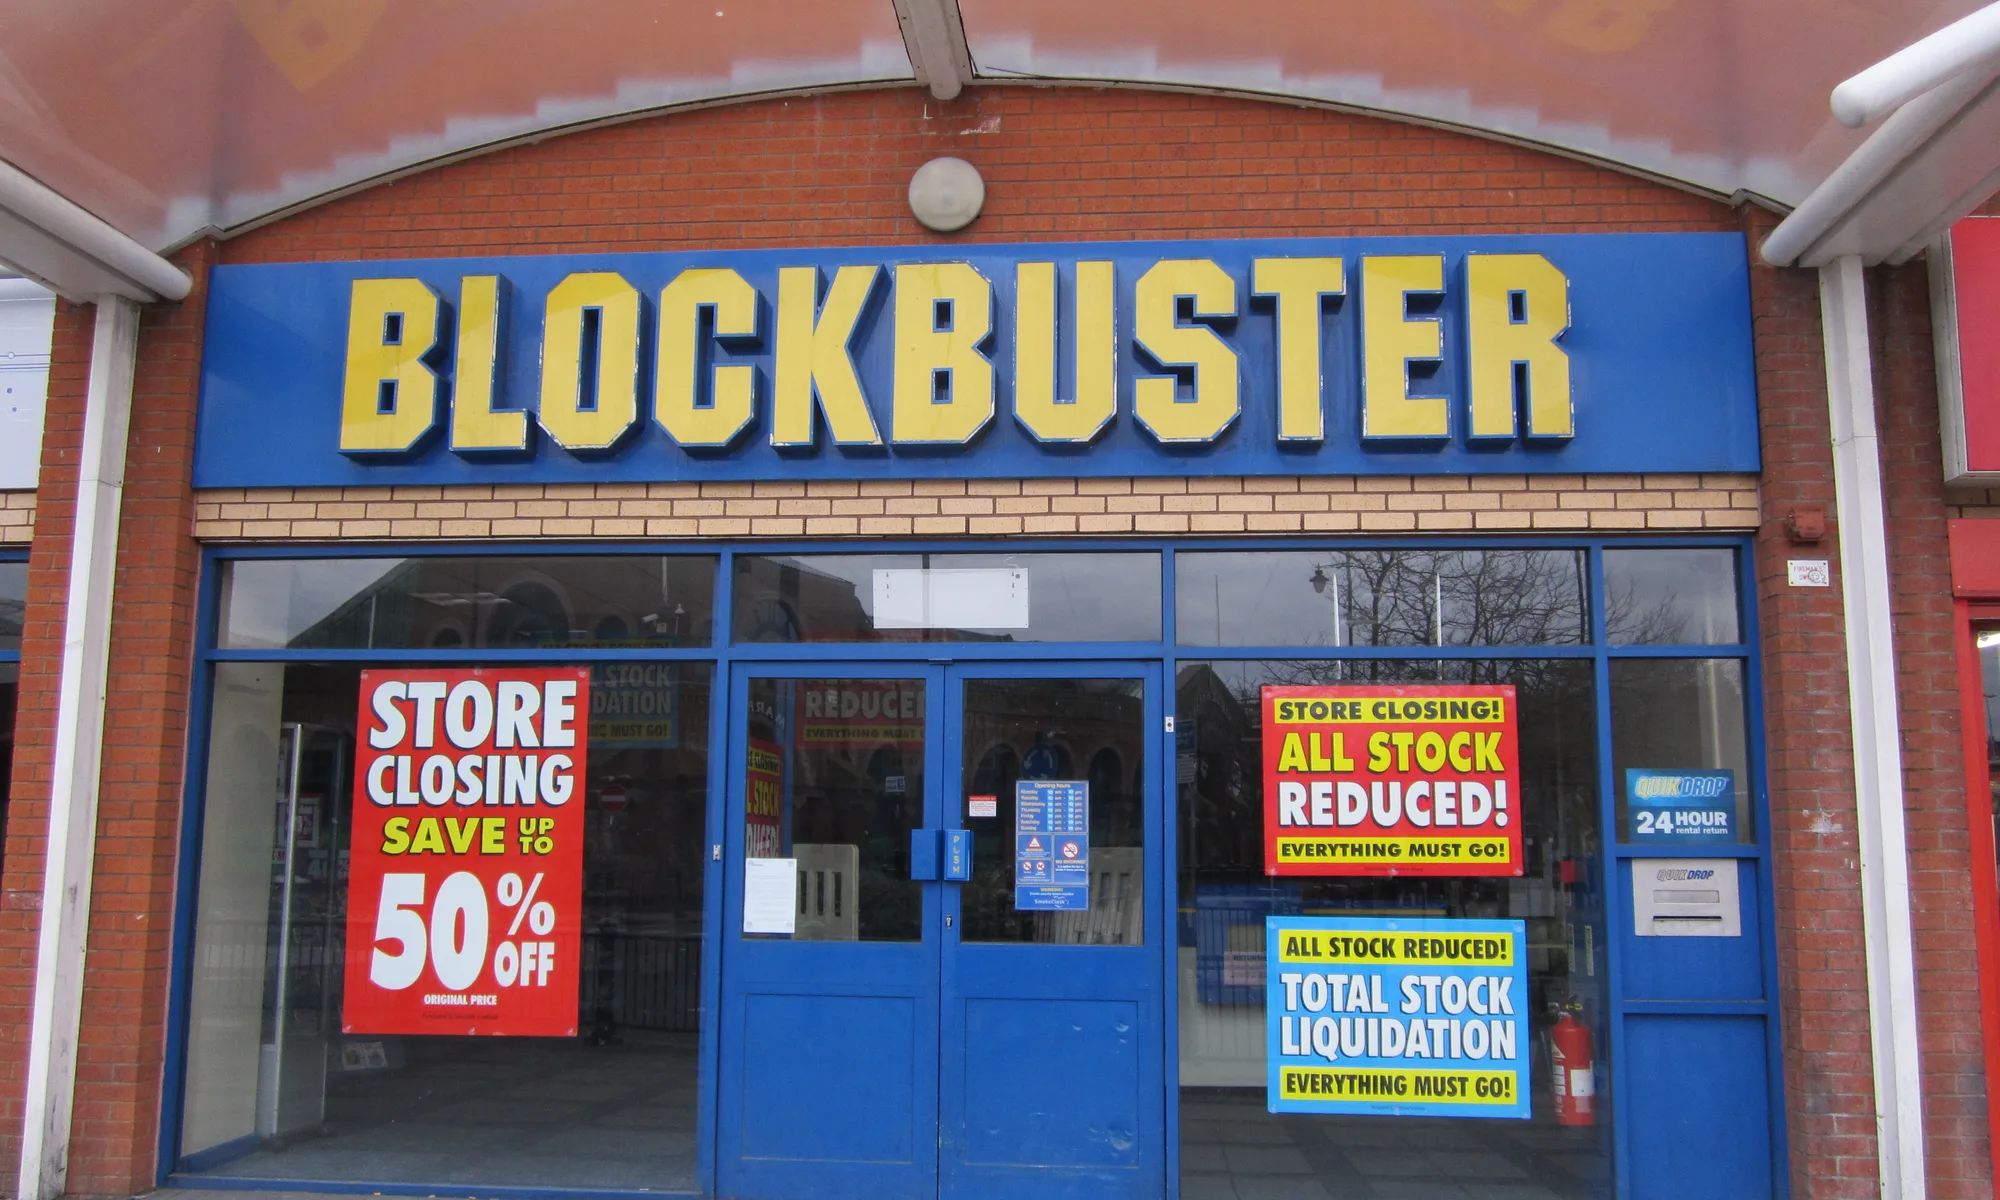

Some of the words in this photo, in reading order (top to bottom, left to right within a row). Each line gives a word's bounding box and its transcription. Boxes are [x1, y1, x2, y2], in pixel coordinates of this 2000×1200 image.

[338, 251, 1577, 452] BLOCKBUSTER
[368, 680, 577, 749] STORE
[591, 690, 671, 714] DATION
[1279, 701, 1362, 720] STORE
[1372, 701, 1500, 720] CLOSING!
[1277, 731, 1355, 773] ALL
[1367, 731, 1505, 773] STOCK
[366, 754, 574, 807] CLOSING
[1635, 776, 1728, 799] QUIKDROP
[1277, 779, 1509, 828] REDUCED!
[1637, 811, 1674, 834] 24
[1676, 811, 1728, 826] HOUR
[1676, 827, 1701, 835] rental
[1703, 827, 1728, 835] return
[381, 816, 506, 855] SAVE
[519, 817, 555, 836] UP
[518, 836, 554, 855] TO
[1281, 843, 1402, 858] EVERYTHING
[1408, 843, 1461, 858] MUST
[1469, 843, 1505, 858] GO!
[1657, 869, 1714, 882] QUIKDROP
[1286, 936, 1322, 957] ALL
[1329, 937, 1397, 959] STOCK
[1403, 938, 1507, 960] REDUCED!
[494, 941, 555, 987] OFF
[424, 994, 468, 1006] ORIGINAL
[470, 994, 498, 1006] PRICE
[1280, 973, 1390, 1013] TOTAL
[1400, 974, 1515, 1015] STOCK
[1280, 1016, 1517, 1062] LIQUIDATION
[1286, 1072, 1408, 1097] EVERYTHING
[1414, 1075, 1469, 1098] MUST
[1475, 1077, 1511, 1099] GO!
